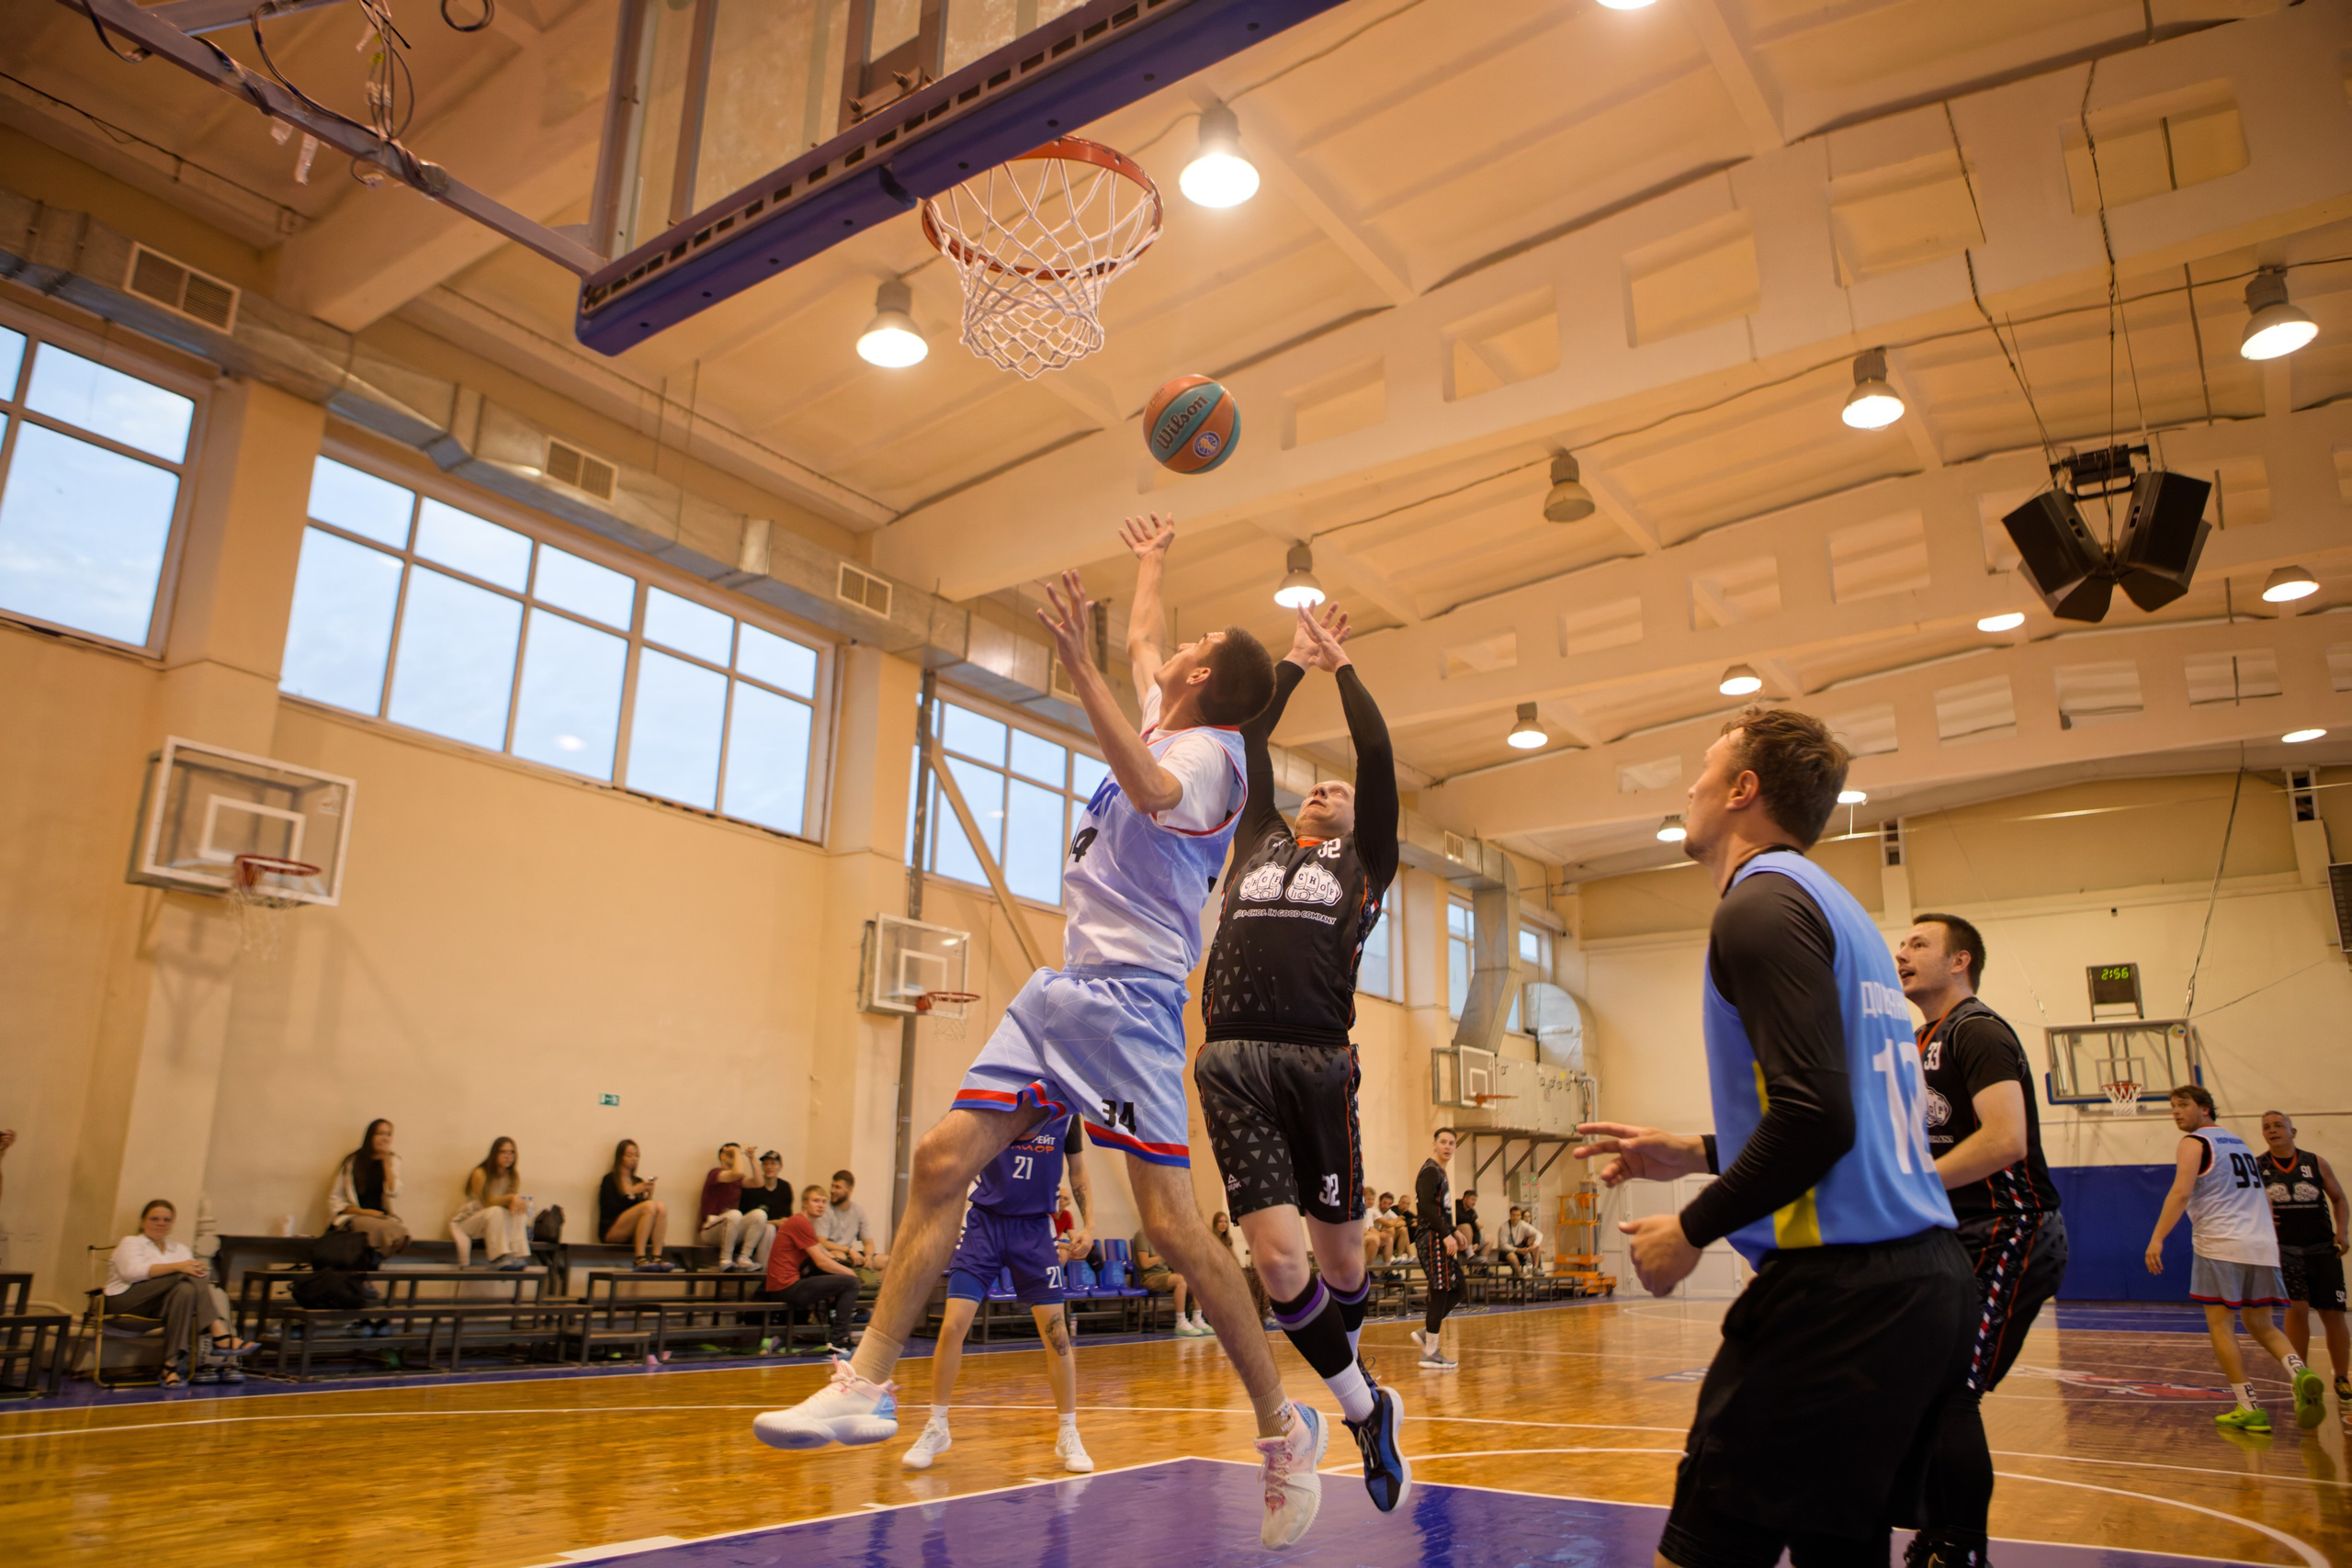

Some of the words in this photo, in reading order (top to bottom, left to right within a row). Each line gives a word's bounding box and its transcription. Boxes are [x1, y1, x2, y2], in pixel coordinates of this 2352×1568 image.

[1156, 395, 1210, 450] Wilson
[1268, 908, 1277, 917] IN
[1277, 909, 1300, 918] GOOD
[1300, 911, 1337, 925] COMPANY
[1924, 1041, 1942, 1071] 33
[1102, 1099, 1136, 1136] 34
[1012, 1156, 1034, 1179] 21
[2229, 1153, 2261, 1189] 99
[2301, 1165, 2313, 1179] 91
[1318, 1173, 1340, 1207] 32
[1046, 1265, 1063, 1289] 21
